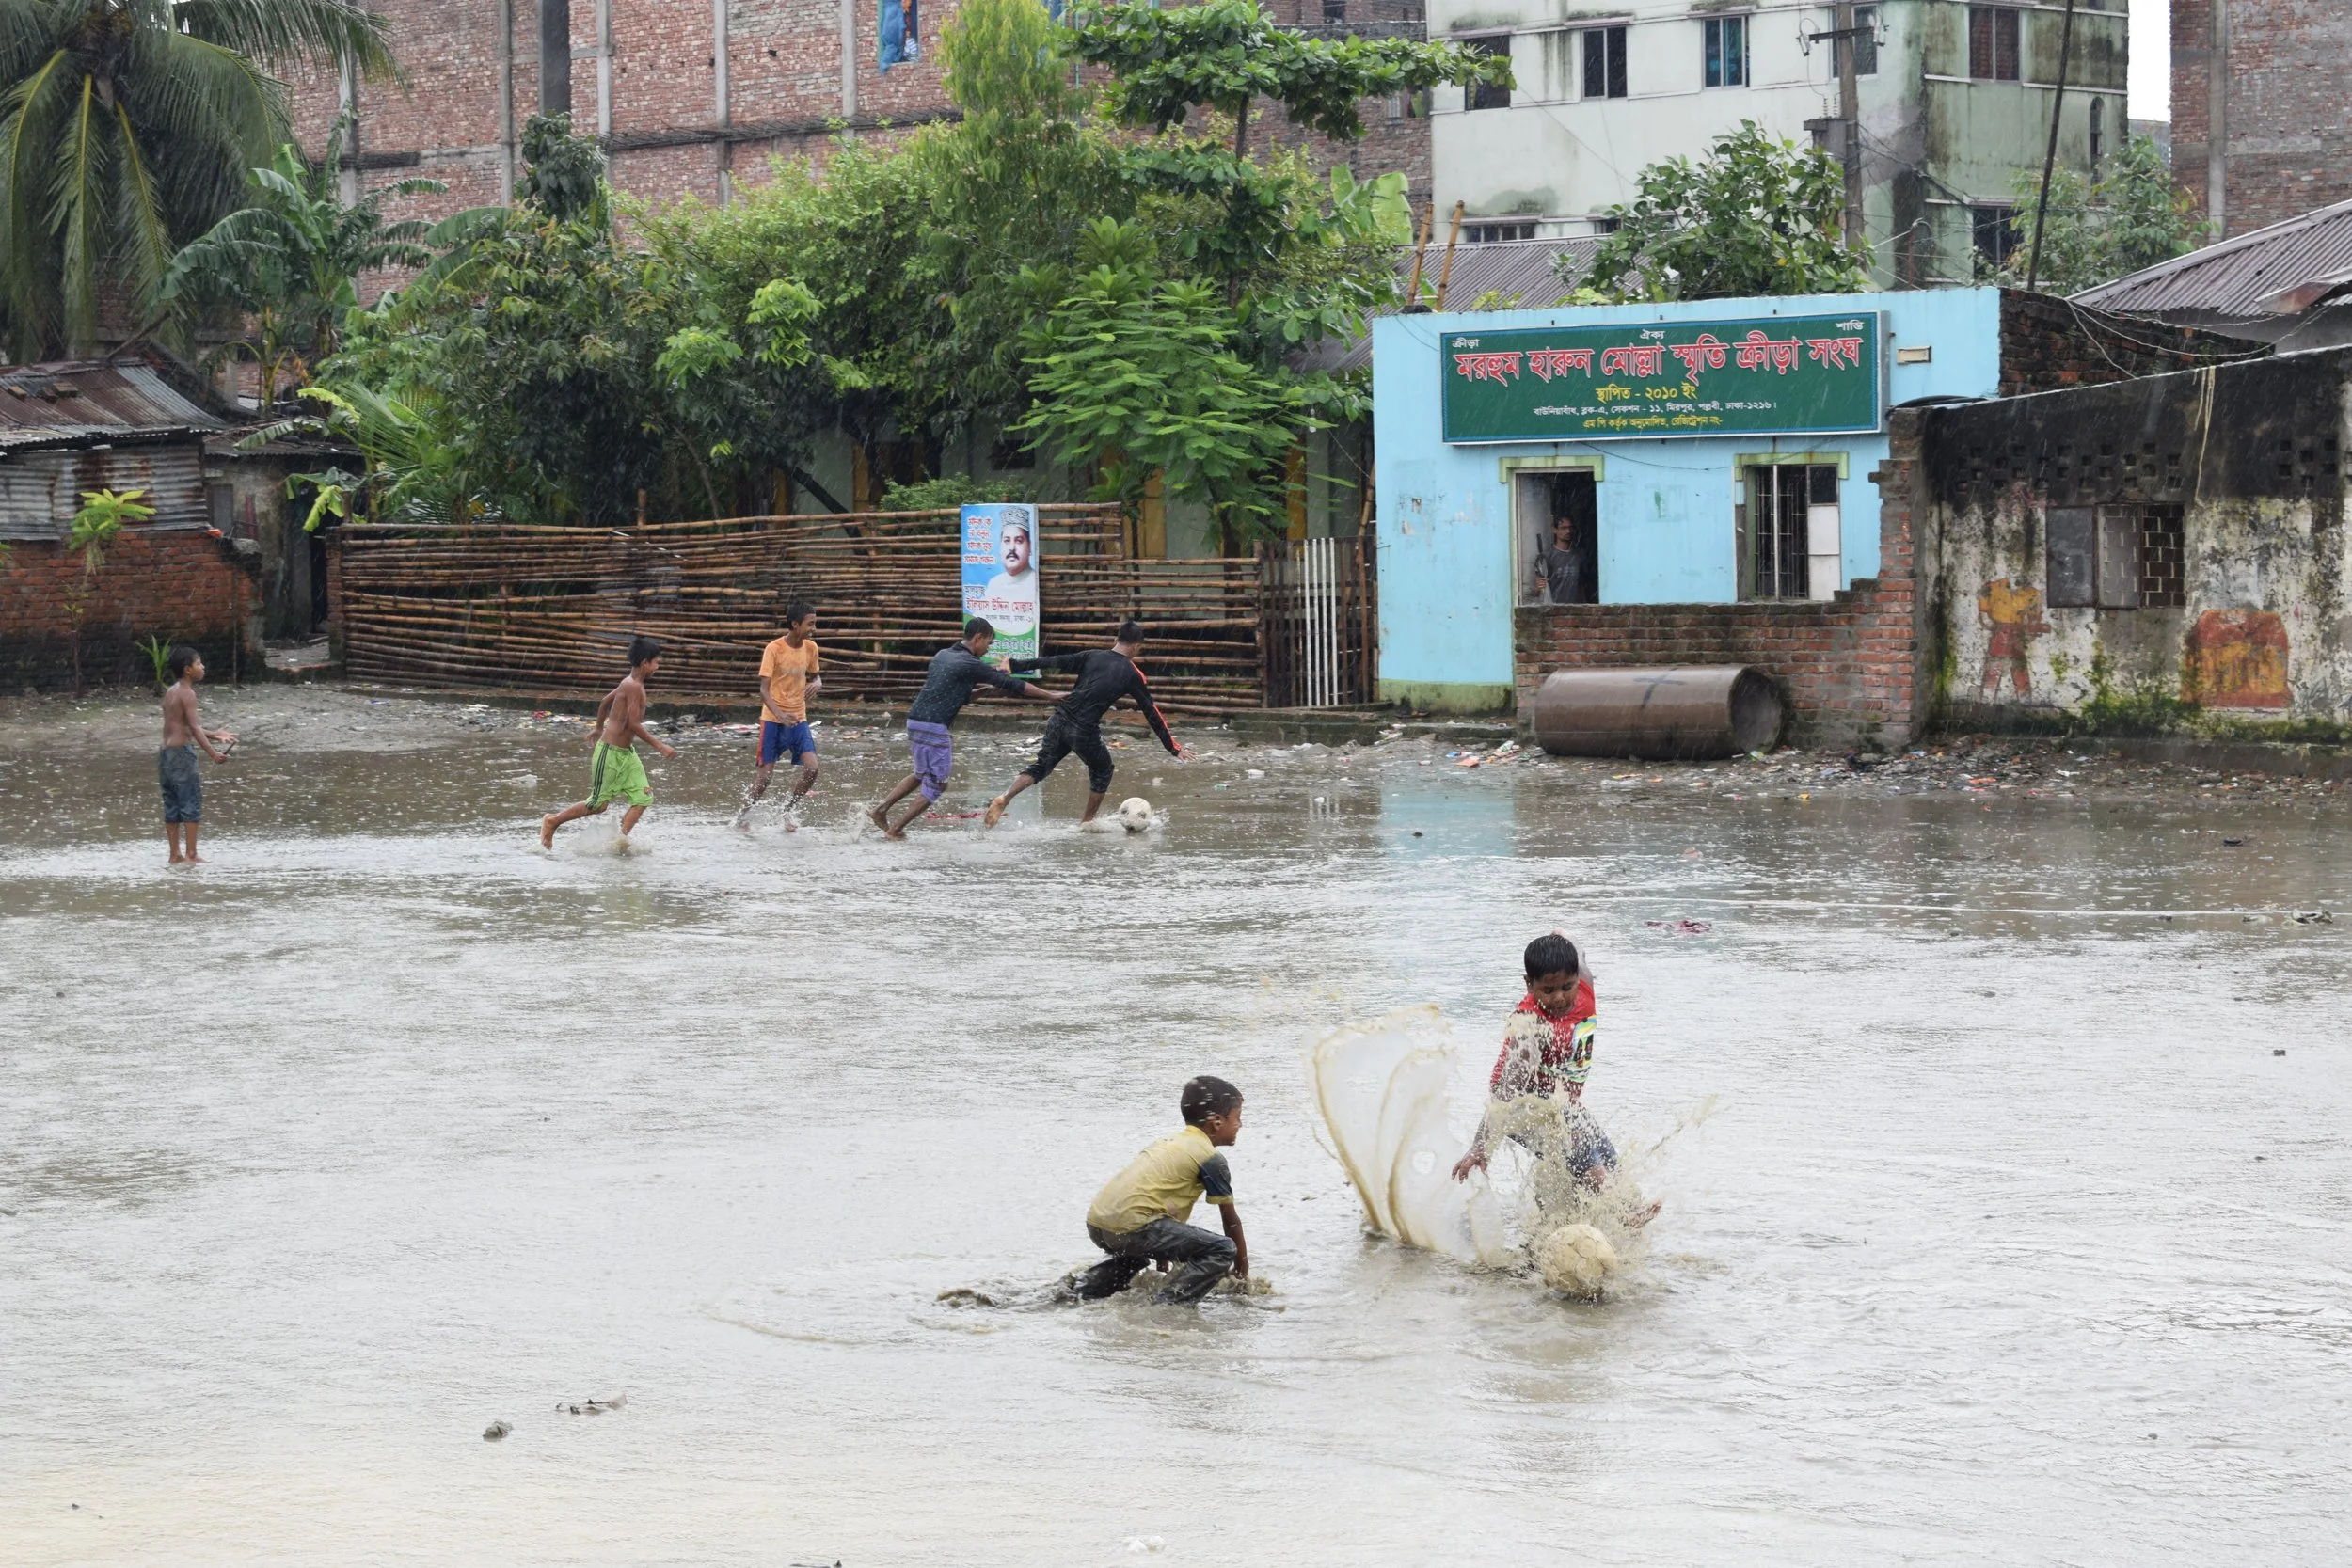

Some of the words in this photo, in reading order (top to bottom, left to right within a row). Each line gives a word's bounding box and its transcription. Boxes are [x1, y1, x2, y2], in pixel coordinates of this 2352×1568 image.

[1454, 352, 1523, 387] মরহুম
[1526, 346, 1595, 383] হারুন
[1600, 341, 1666, 378] মোল্লা
[1669, 333, 1730, 386] স্মৃতি
[1733, 330, 1802, 375] ক্রীড়া
[1805, 337, 1864, 370] সংঘ
[1595, 383, 1632, 404] স্থাপিত
[1645, 386, 1678, 402] ২০১০
[1681, 381, 1697, 400] ইং
